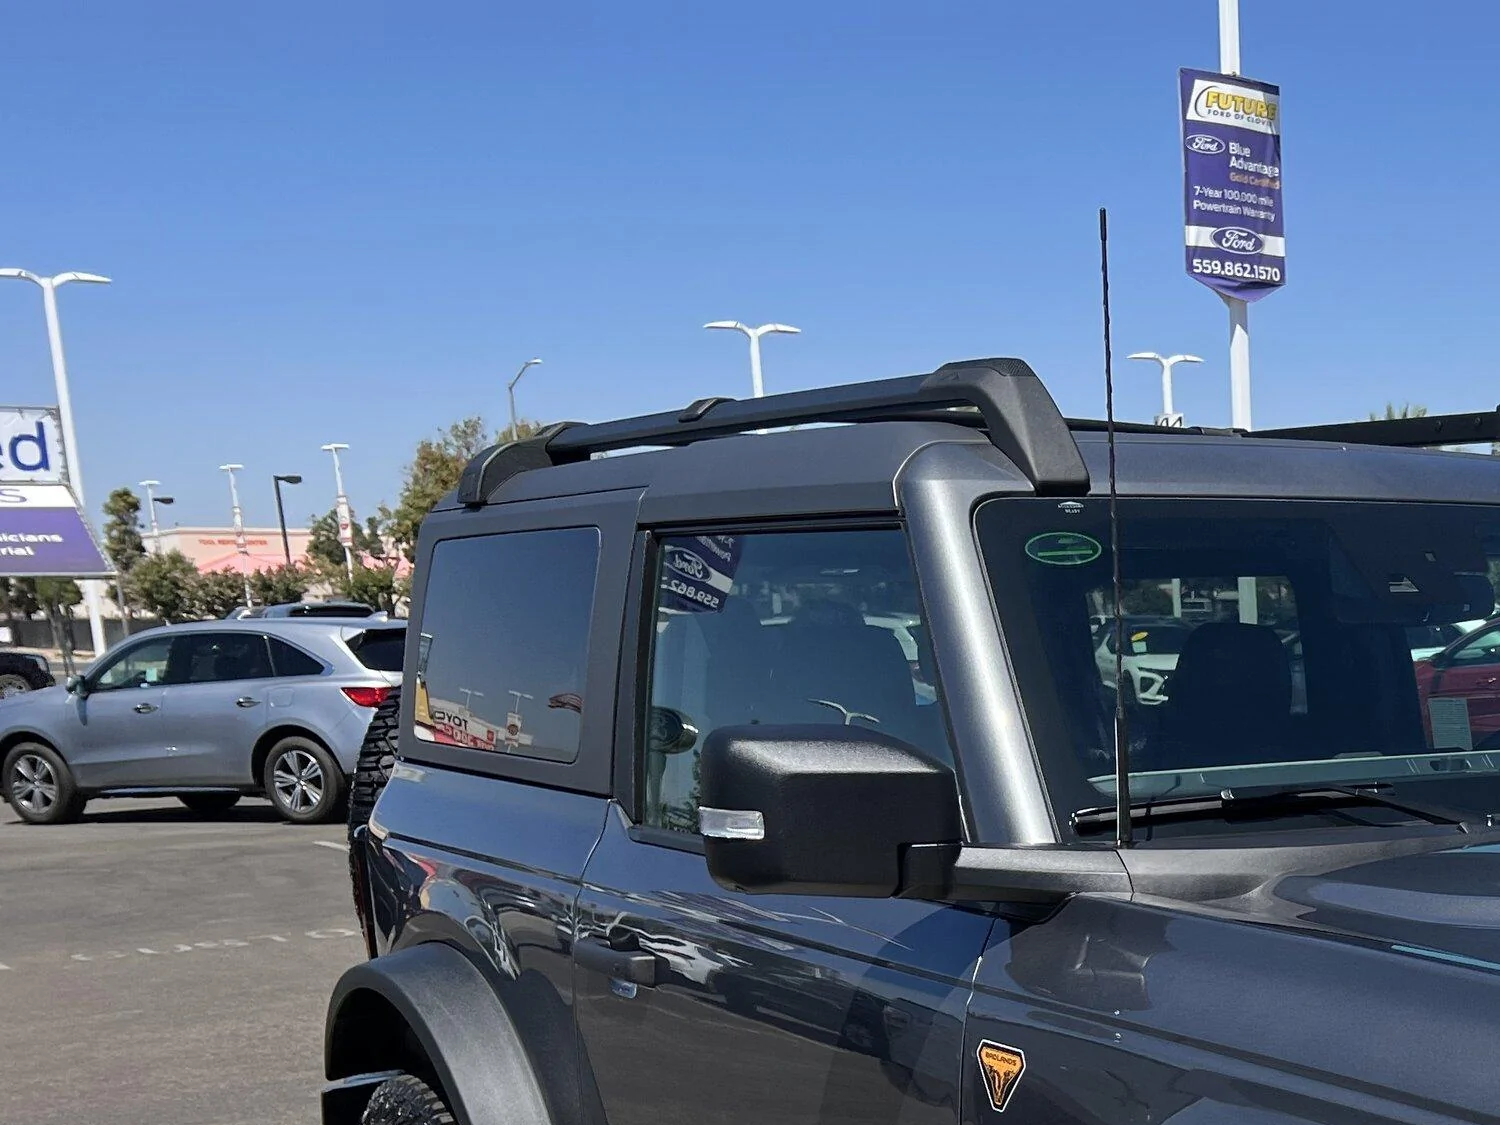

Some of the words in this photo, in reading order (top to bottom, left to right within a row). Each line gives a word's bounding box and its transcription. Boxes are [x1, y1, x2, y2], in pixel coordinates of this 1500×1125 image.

[1206, 90, 1277, 120] FUTURE
[1207, 108, 1232, 118] FORD
[1192, 136, 1219, 151] Ford
[1228, 142, 1251, 157] Blue
[1229, 156, 1280, 177] Advantage
[1193, 185, 1223, 198] 7-Year
[1193, 199, 1242, 215] Powertrain
[1220, 230, 1256, 251] Ford
[1192, 258, 1281, 282] 559.862.1570
[0, 421, 51, 472] d
